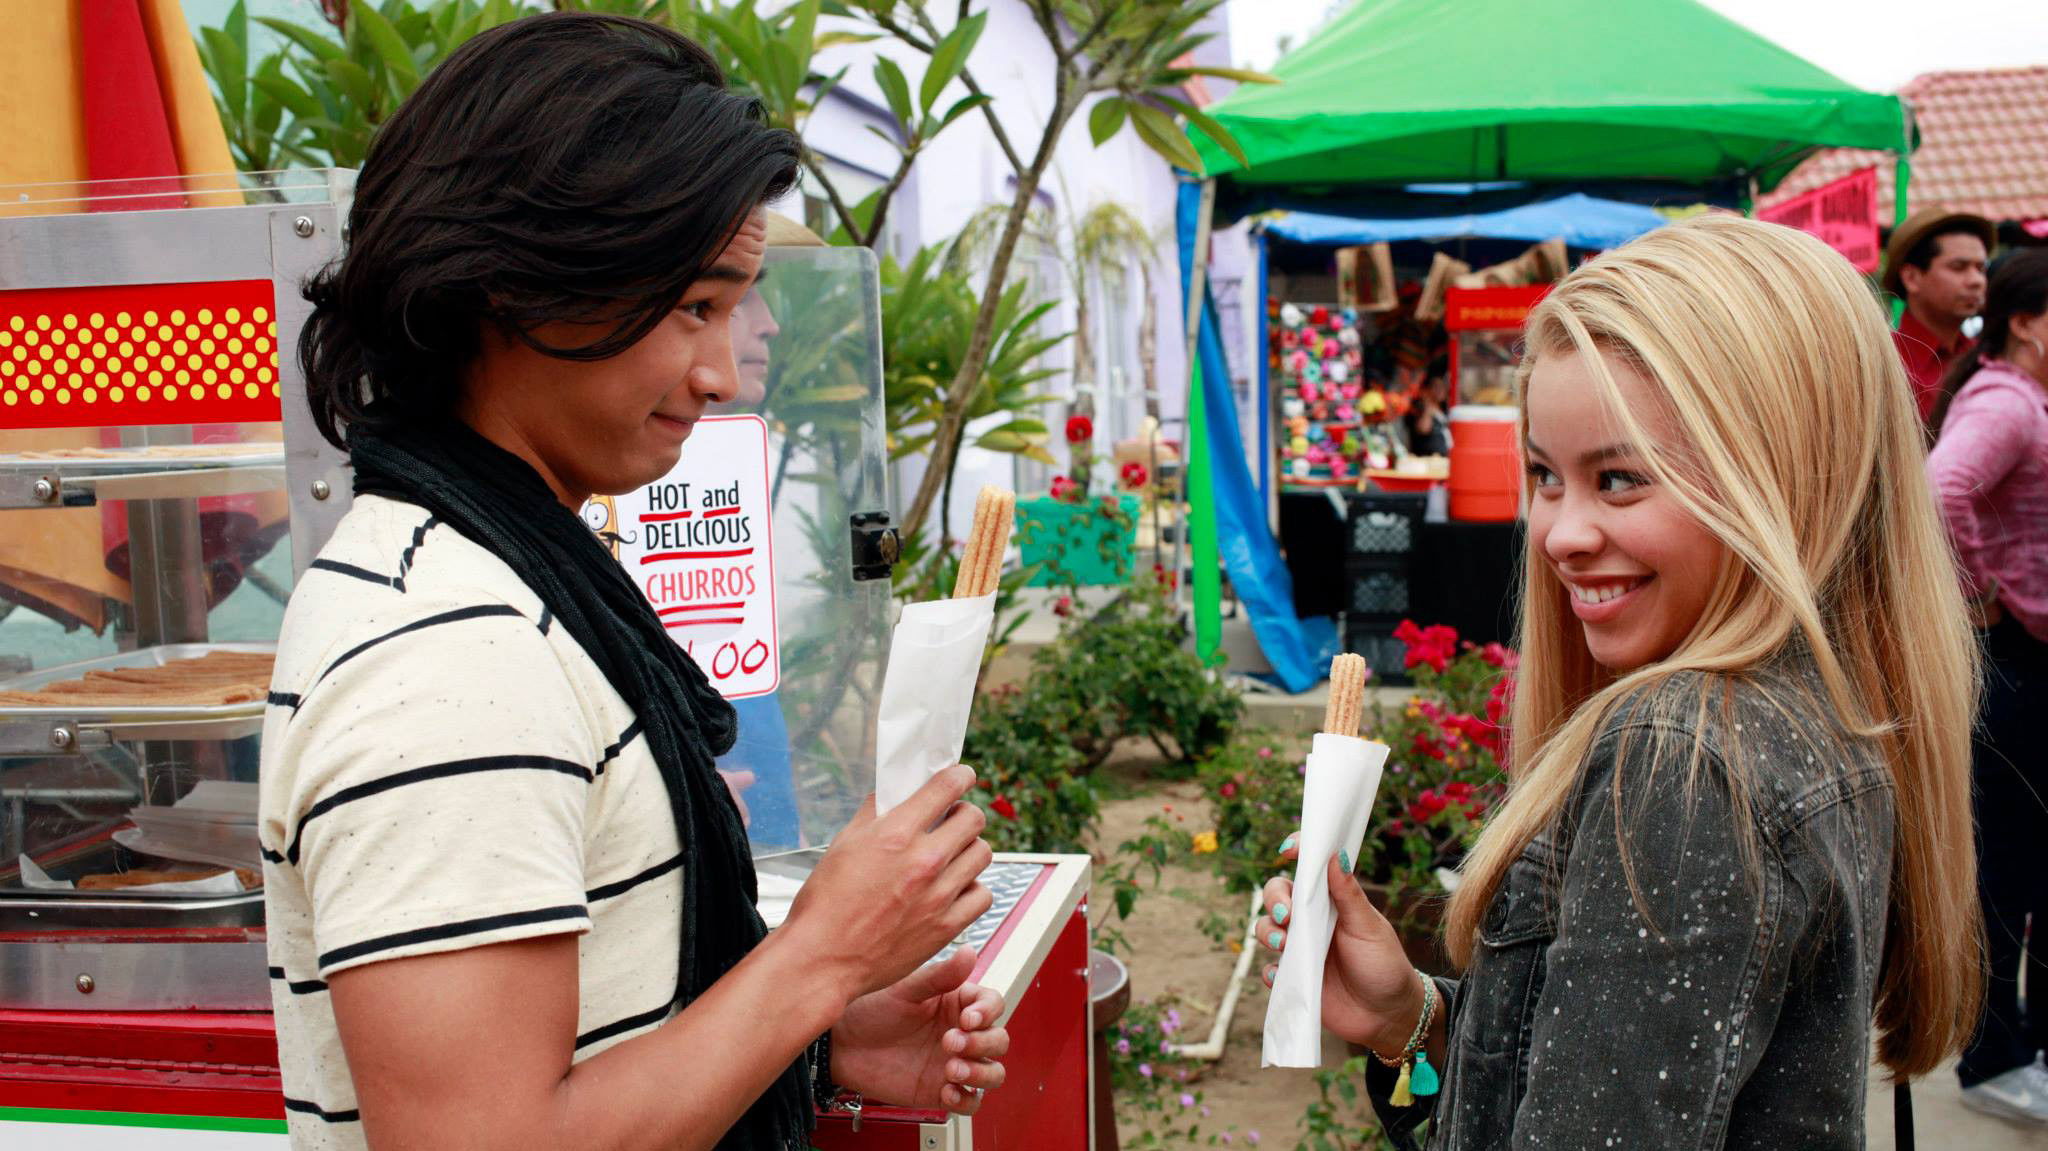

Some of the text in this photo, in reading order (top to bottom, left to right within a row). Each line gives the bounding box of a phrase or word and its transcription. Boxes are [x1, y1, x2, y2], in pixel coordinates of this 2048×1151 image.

[648, 479, 740, 511] HOT and
[645, 516, 751, 550] DELICIOUS
[646, 564, 756, 604] CHURROS
